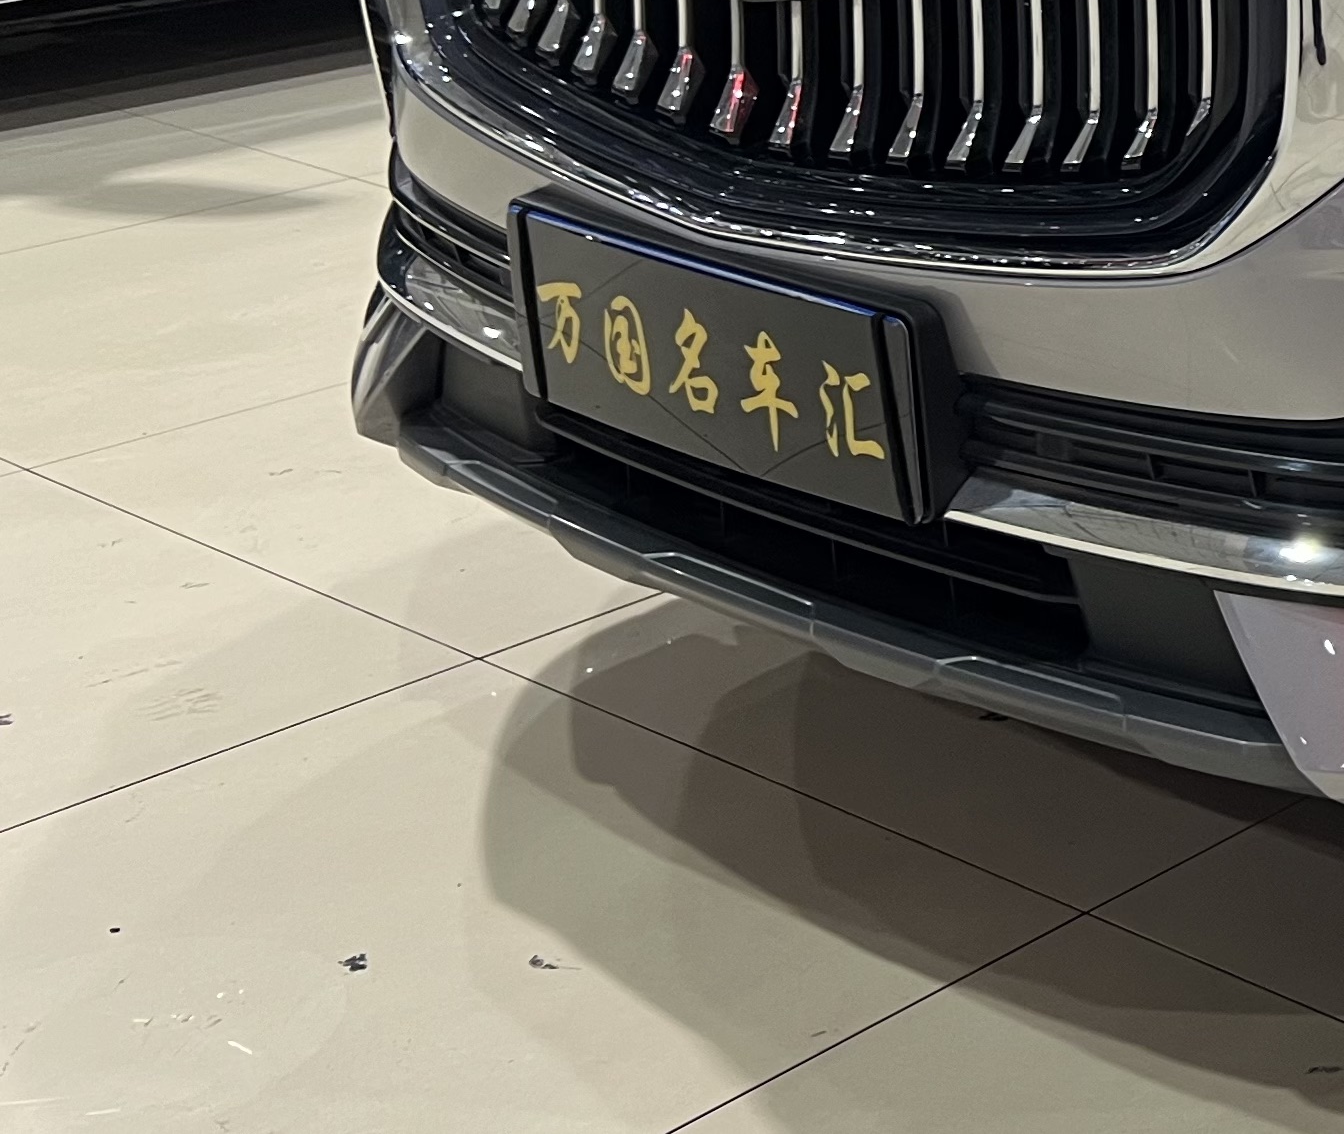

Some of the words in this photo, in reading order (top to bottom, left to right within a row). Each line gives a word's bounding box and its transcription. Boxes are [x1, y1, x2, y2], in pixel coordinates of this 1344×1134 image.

[536, 281, 886, 460] 万国名车汇
